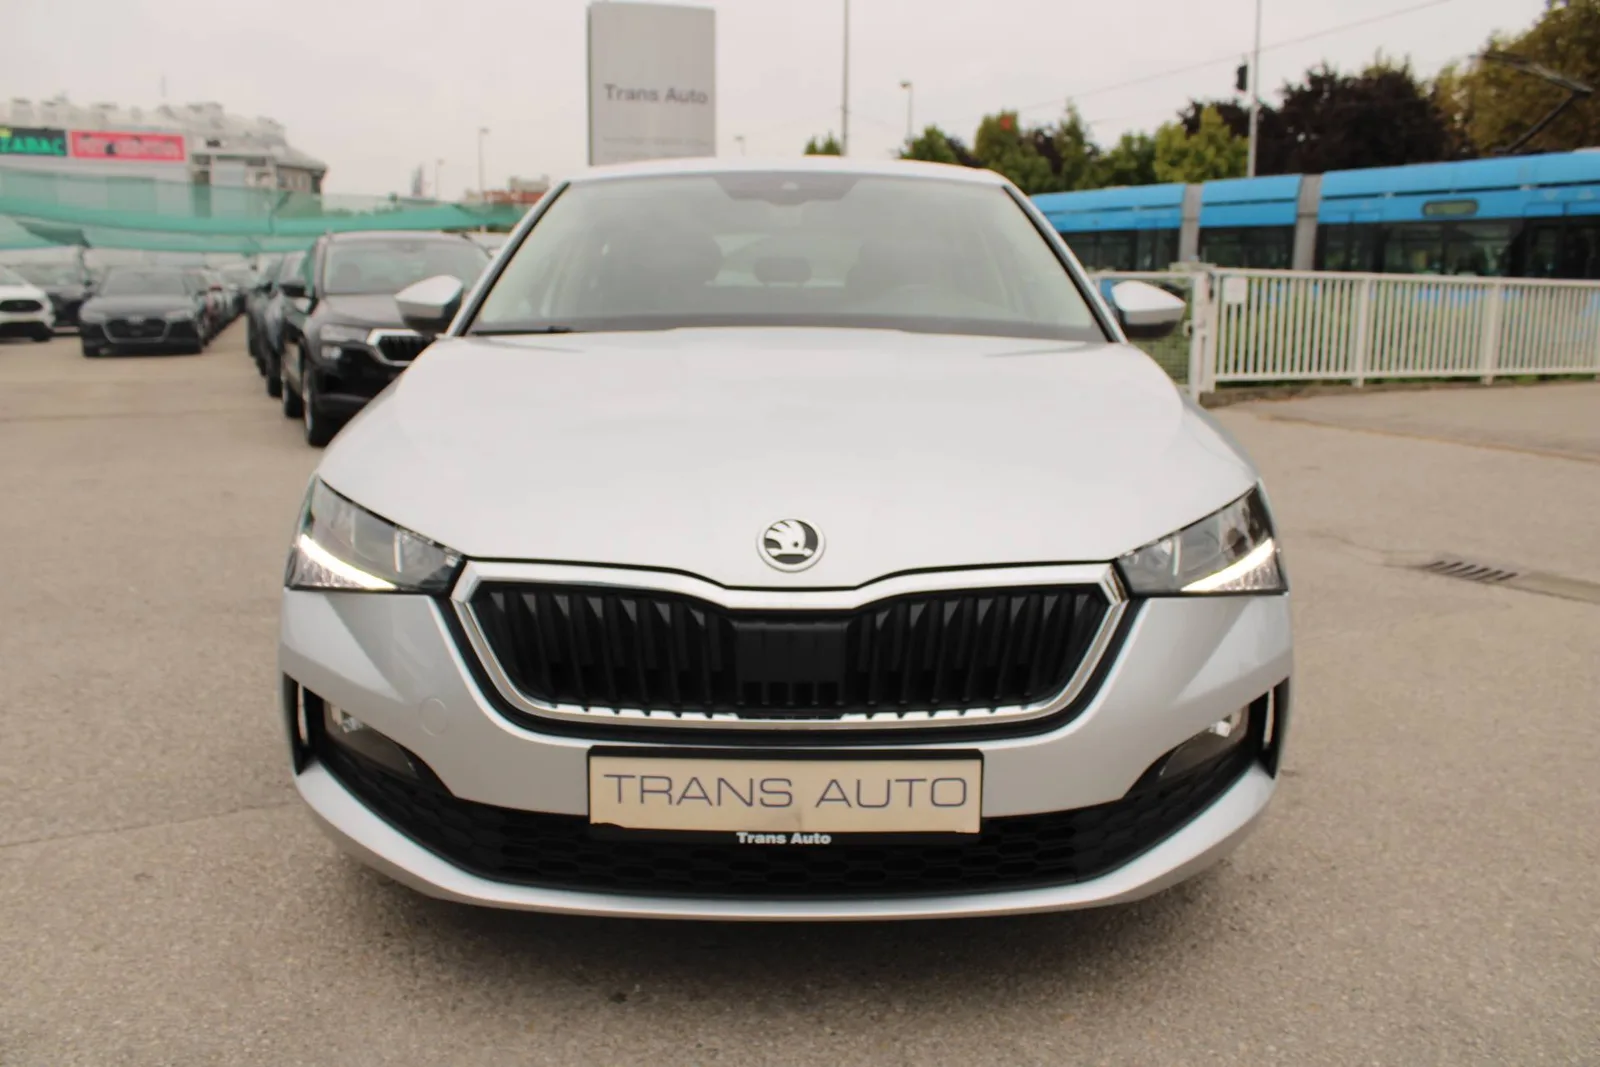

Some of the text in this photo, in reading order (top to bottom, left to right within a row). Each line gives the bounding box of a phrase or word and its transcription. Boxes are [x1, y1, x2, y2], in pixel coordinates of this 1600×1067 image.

[604, 83, 709, 104] Trans Auto
[603, 774, 968, 808] TRANS AUTO
[736, 832, 831, 844] Trans Auto
